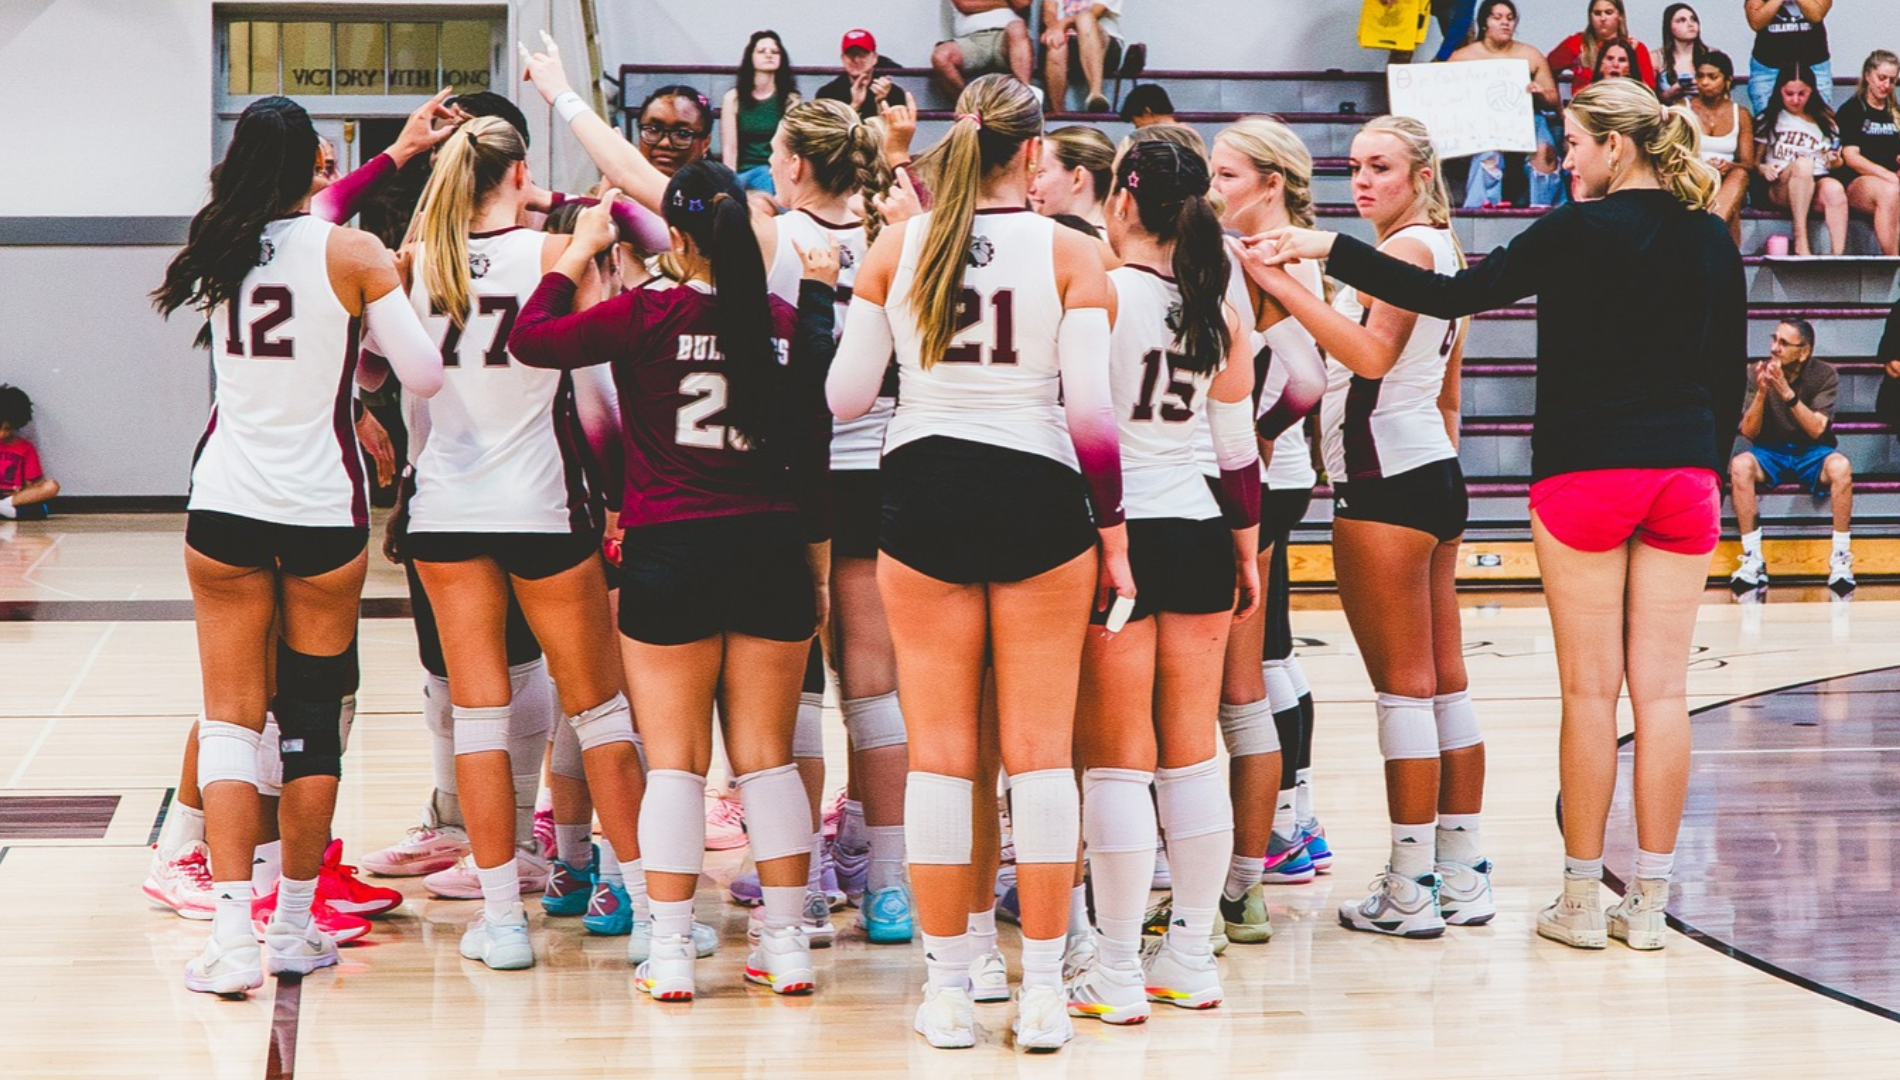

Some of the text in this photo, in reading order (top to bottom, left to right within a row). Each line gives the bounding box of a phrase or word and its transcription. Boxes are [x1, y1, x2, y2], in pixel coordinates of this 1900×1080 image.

[292, 69, 378, 86] VICTORY
[381, 69, 430, 86] WITH
[225, 283, 296, 360] 12
[675, 371, 757, 452] 2
[1130, 346, 1201, 423] 15
